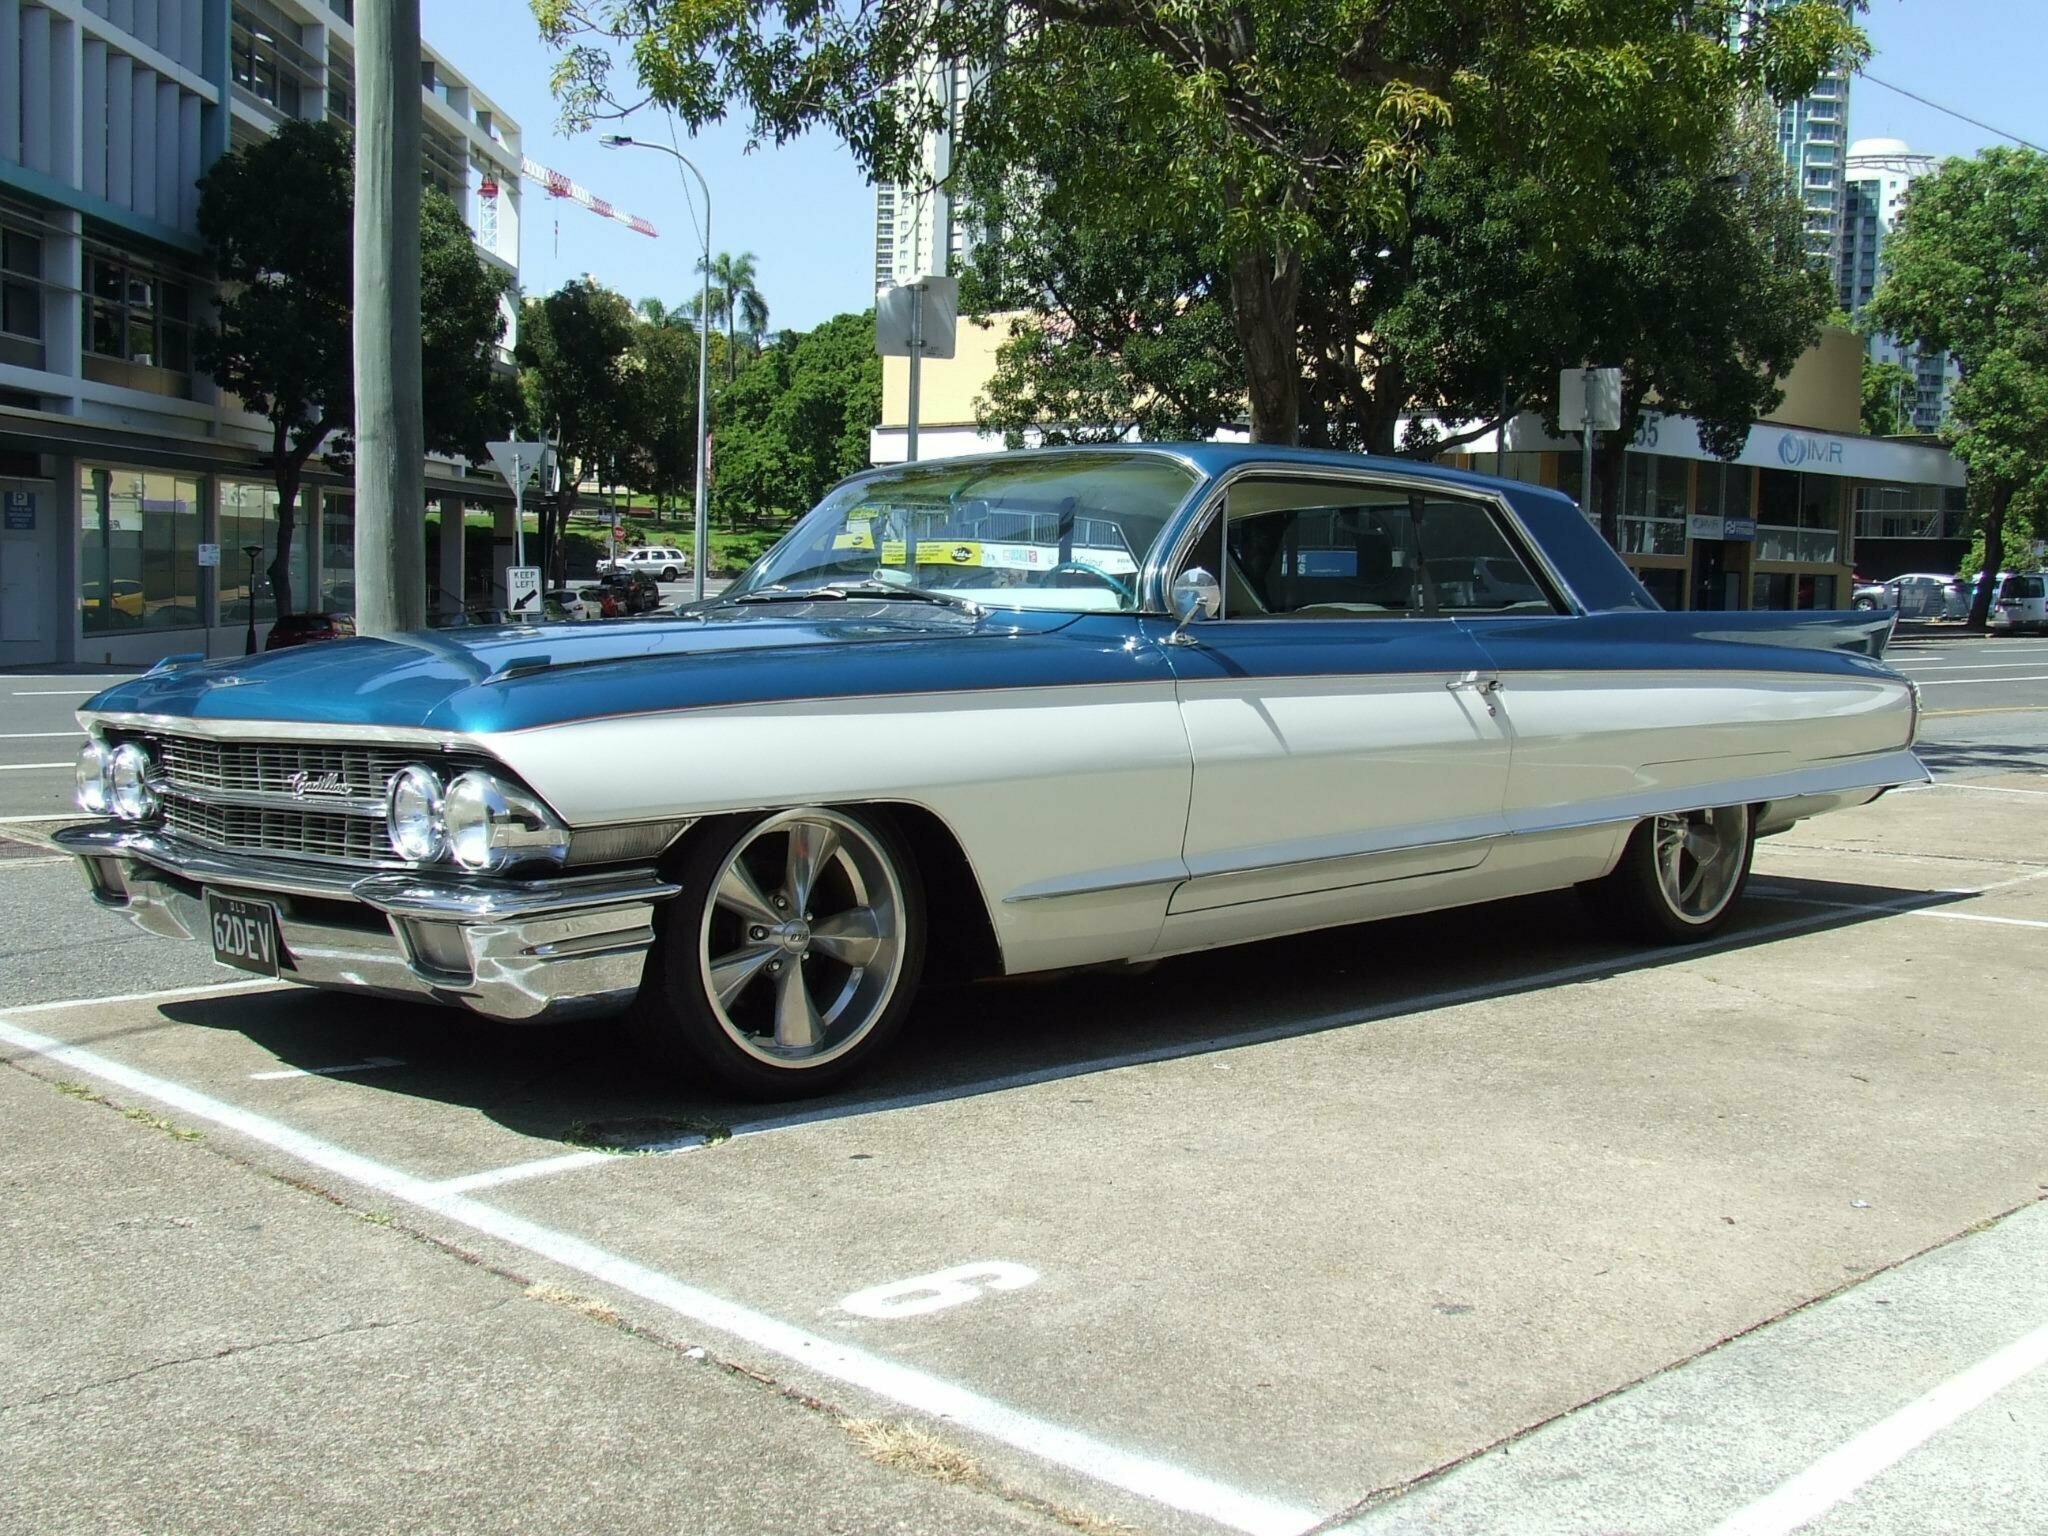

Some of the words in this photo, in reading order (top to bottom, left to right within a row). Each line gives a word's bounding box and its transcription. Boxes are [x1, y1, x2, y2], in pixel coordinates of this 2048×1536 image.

[1807, 439, 1843, 463] IMR
[514, 571, 535, 579] KEEP
[515, 580, 534, 589] LEFT
[288, 771, 352, 795] Cadillac
[213, 911, 269, 963] 62DEV
